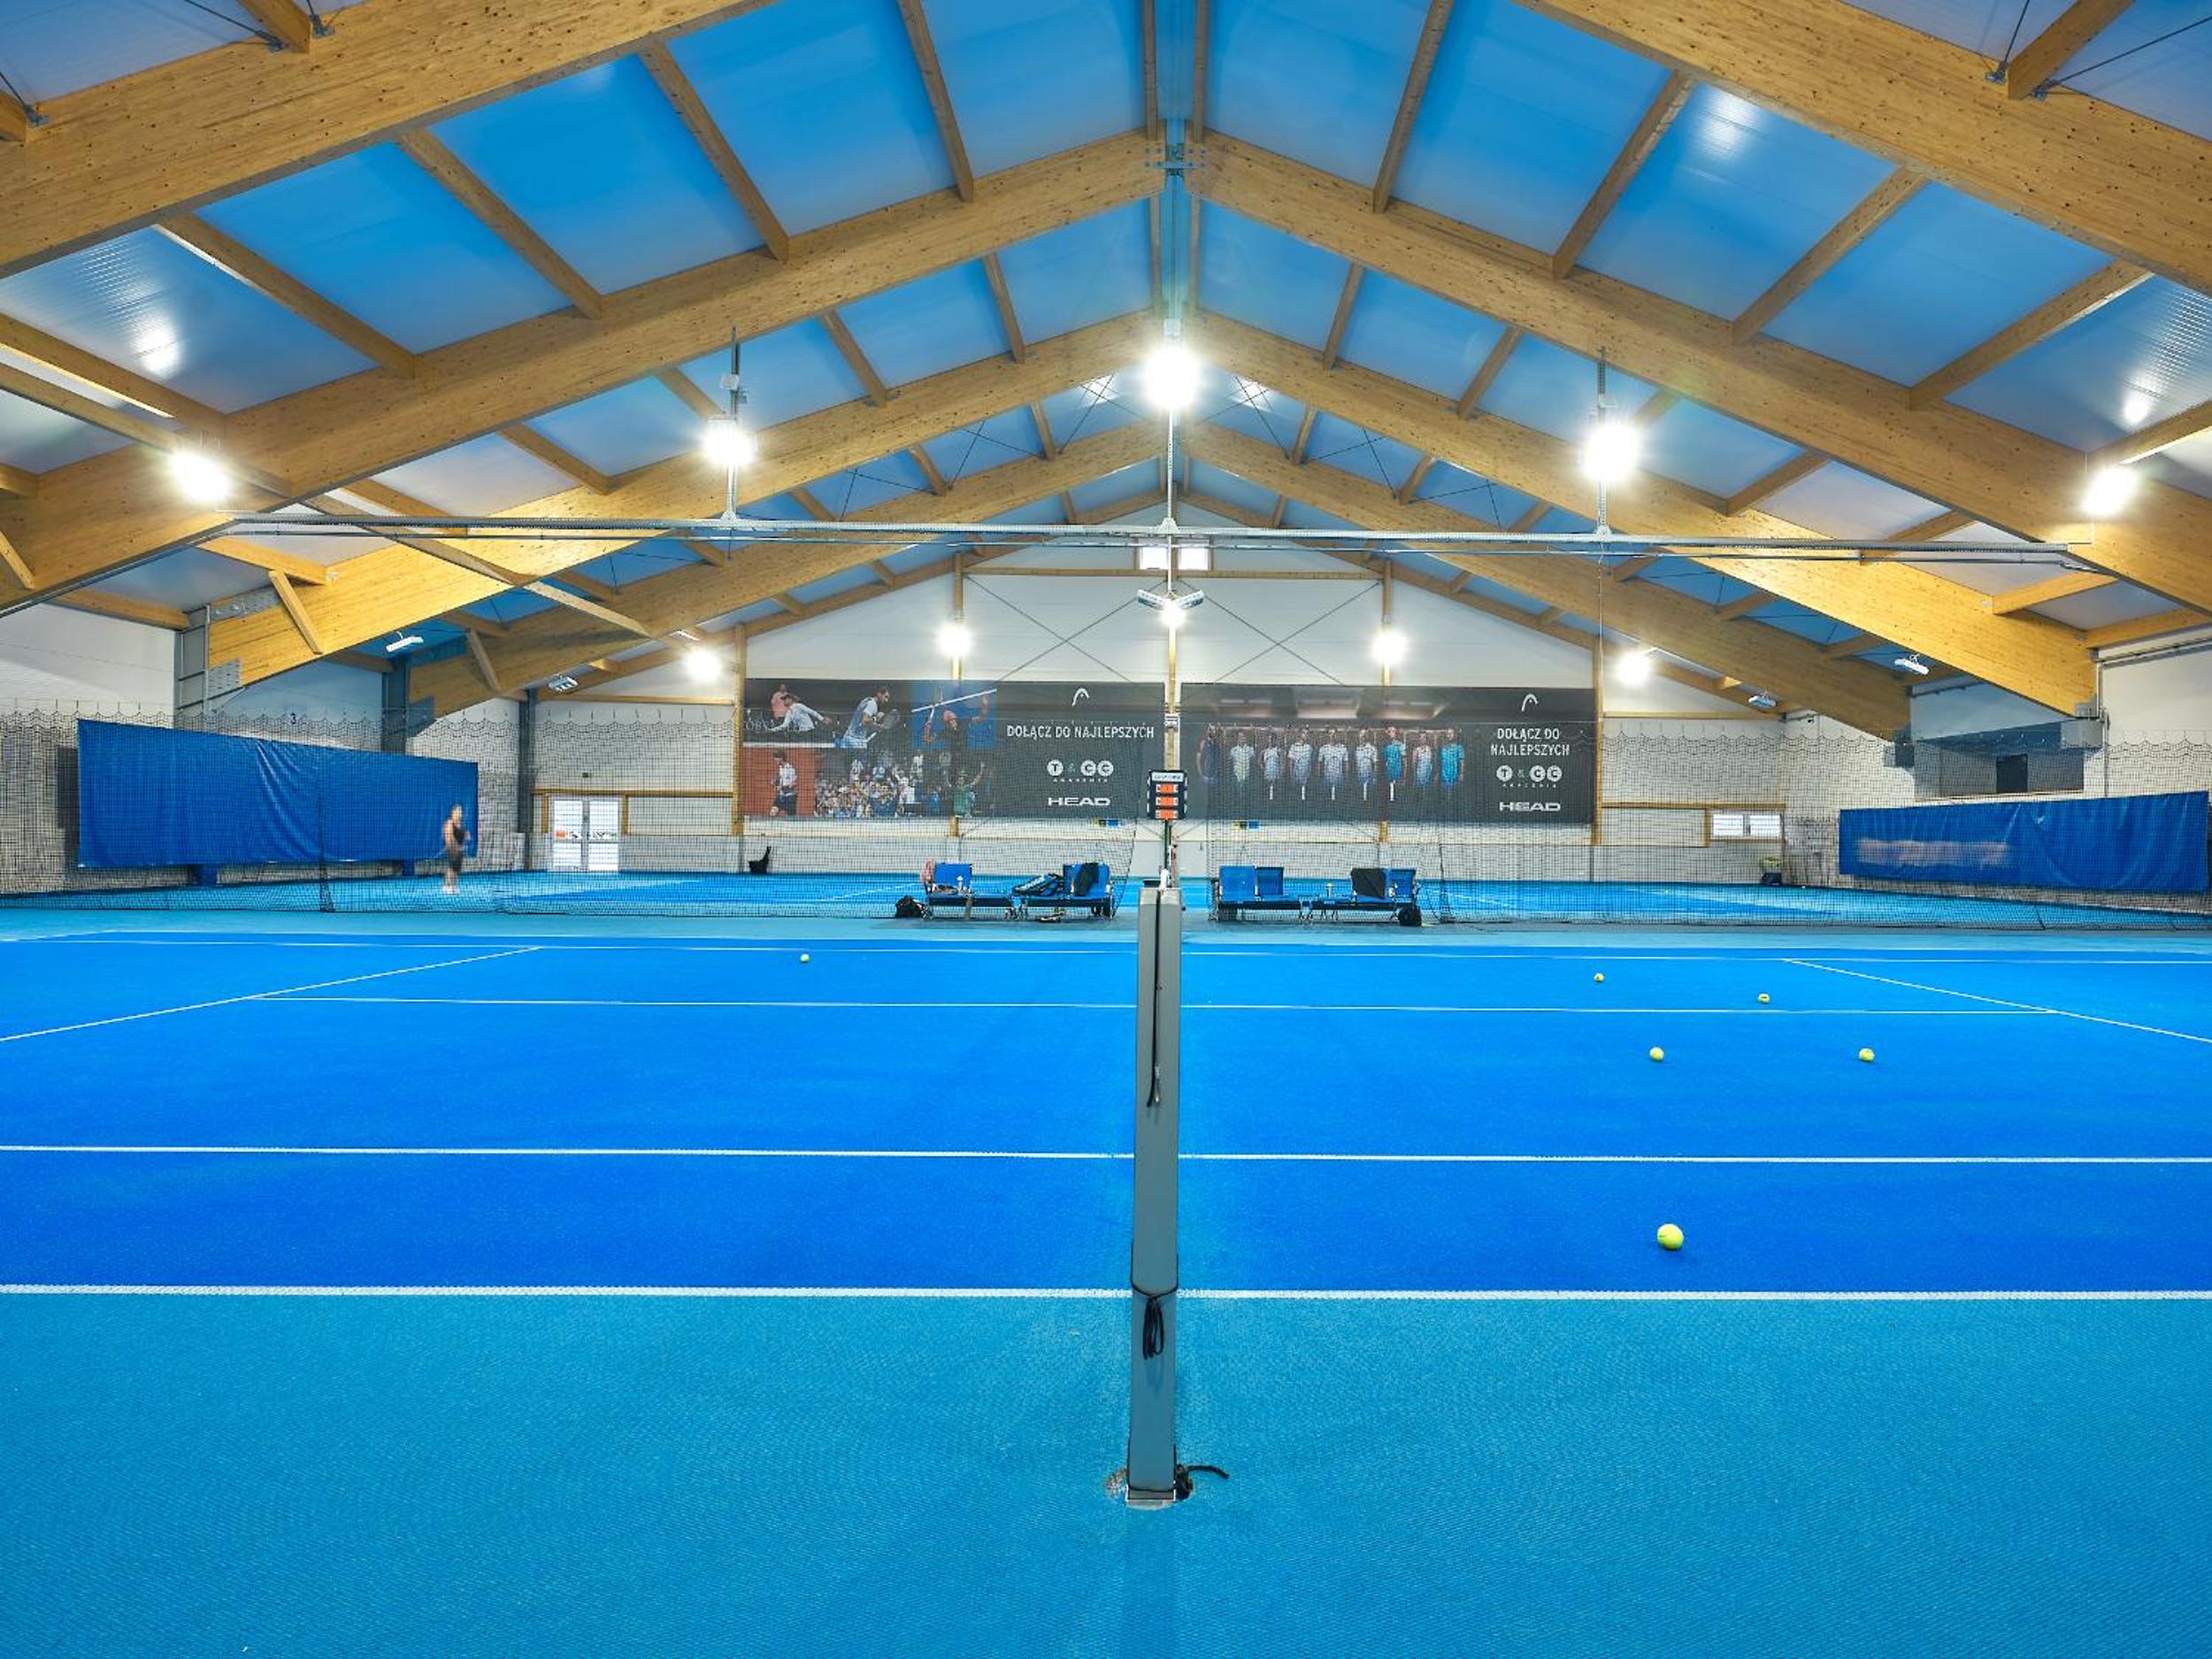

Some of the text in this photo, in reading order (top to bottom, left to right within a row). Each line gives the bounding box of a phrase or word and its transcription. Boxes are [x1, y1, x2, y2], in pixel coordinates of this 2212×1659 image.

[1007, 725, 1155, 741] DOŁĄCZ DO NAJLEPSZYCH
[1497, 727, 1560, 742] DOŁĄCZ DO
[1490, 743, 1570, 756] NAJLEPSZYCH
[1048, 797, 1110, 806] HEAD
[1499, 802, 1561, 811] HEAD
